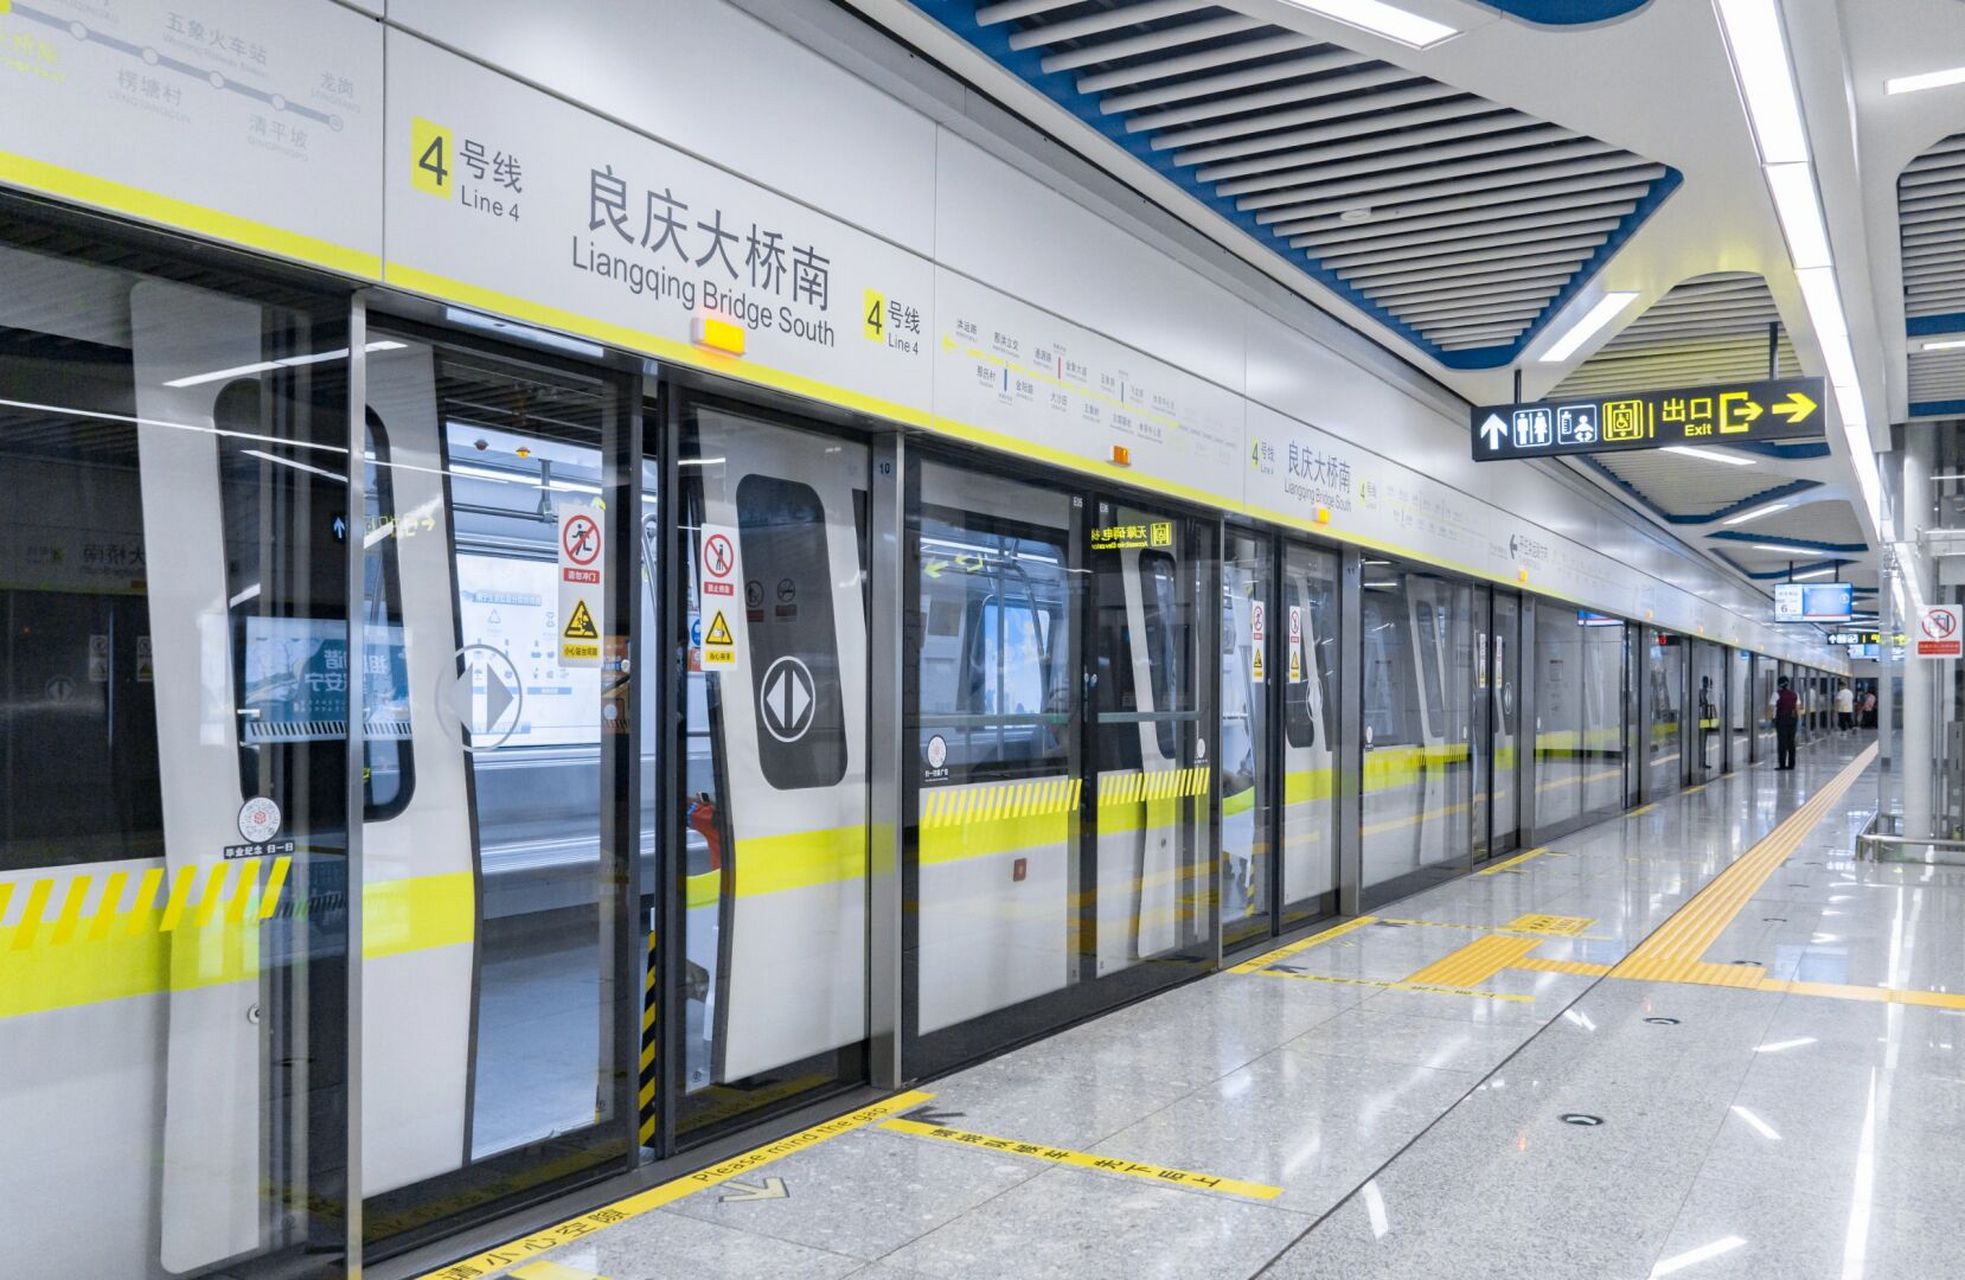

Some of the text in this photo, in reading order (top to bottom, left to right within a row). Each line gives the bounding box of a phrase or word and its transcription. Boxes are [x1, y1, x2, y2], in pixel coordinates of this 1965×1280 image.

[418, 135, 522, 193] 4 号线
[461, 184, 519, 222] Line 4
[589, 164, 831, 312] 良庆大桥南
[573, 236, 834, 348] Liangqing Bridge South
[867, 299, 921, 335] 4 号线
[888, 332, 919, 356] Line 4
[1662, 398, 1712, 422] 出口
[1685, 423, 1713, 437] Exit
[879, 463, 890, 475] 10
[1251, 443, 1259, 465] 4
[1288, 440, 1351, 494] 良庆大桥南
[692, 1153, 763, 1183] Please
[768, 1133, 818, 1155] mind
[817, 1118, 850, 1140] the
[1094, 1159, 1223, 1189] 先下后上
[437, 1208, 627, 1280] 请小心空隙
